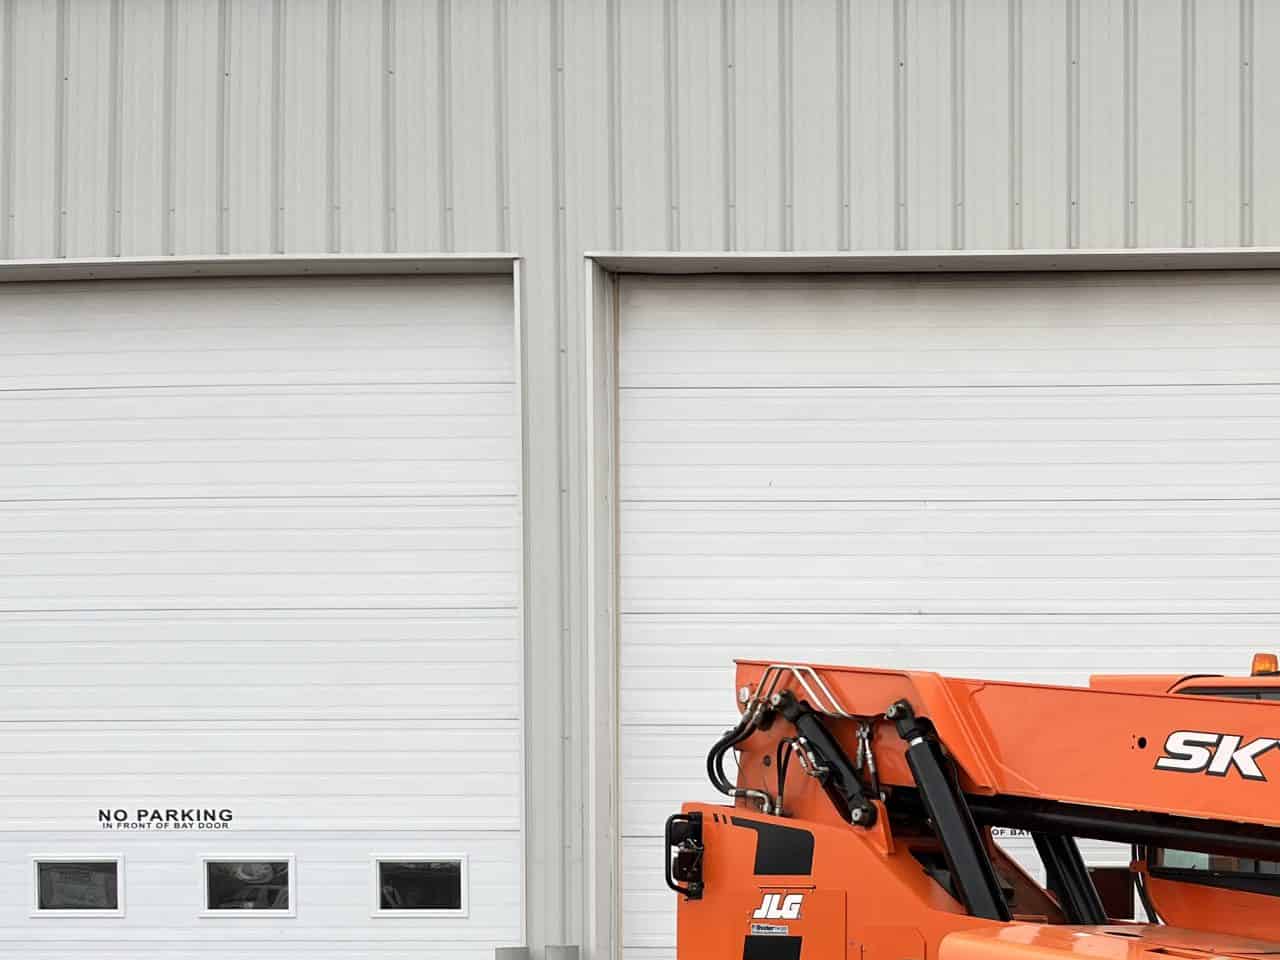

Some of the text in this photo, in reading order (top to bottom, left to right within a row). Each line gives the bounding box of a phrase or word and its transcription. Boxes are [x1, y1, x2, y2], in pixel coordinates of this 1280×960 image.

[98, 808, 233, 822] NO PARKING
[992, 828, 1006, 836] OF
[752, 893, 804, 919] JLG
